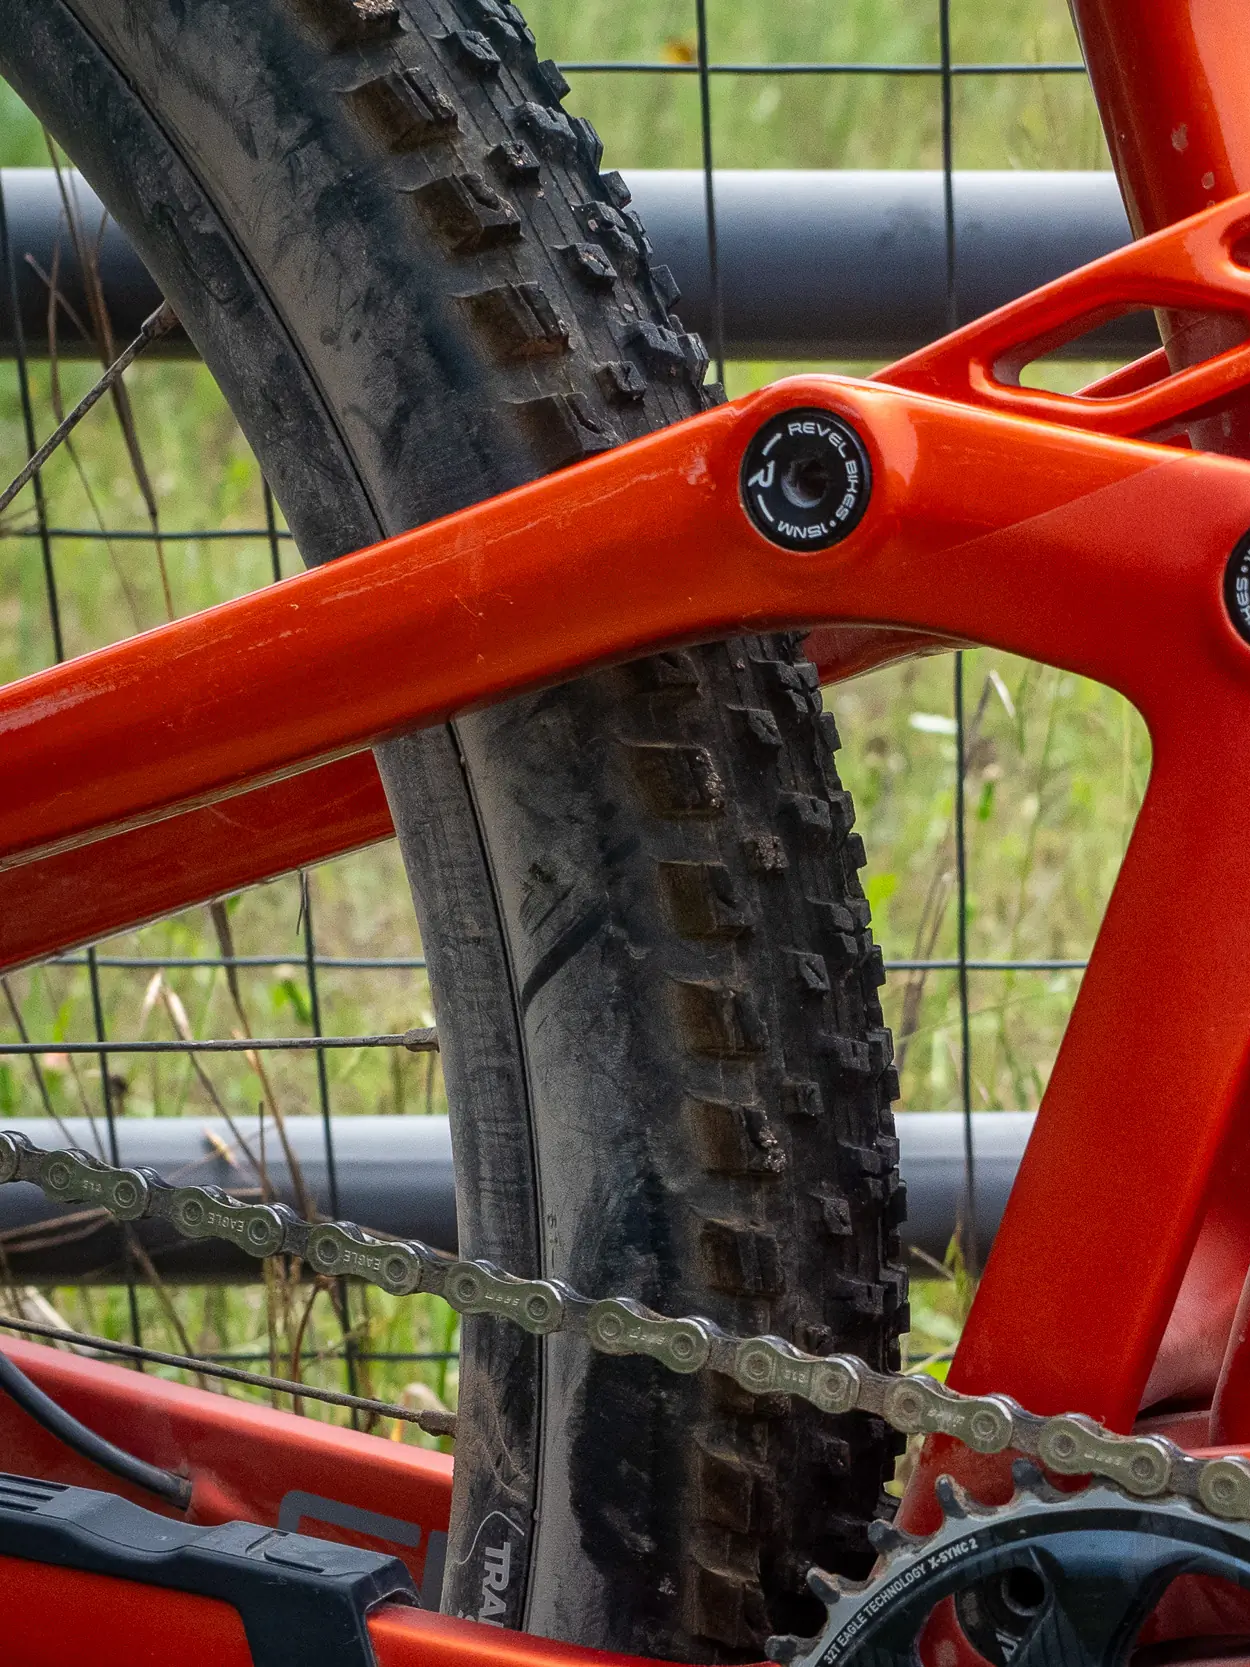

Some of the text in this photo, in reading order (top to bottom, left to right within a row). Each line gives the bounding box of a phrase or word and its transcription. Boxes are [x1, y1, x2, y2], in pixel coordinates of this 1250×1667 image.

[787, 421, 846, 458] REVEL
[835, 459, 859, 521] BIKES
[207, 1211, 244, 1233] EAGLE
[342, 1249, 381, 1271] EAGLE
[823, 1537, 979, 1665] 32T EAGLE TECHNOLOGY X-SYNC 2
